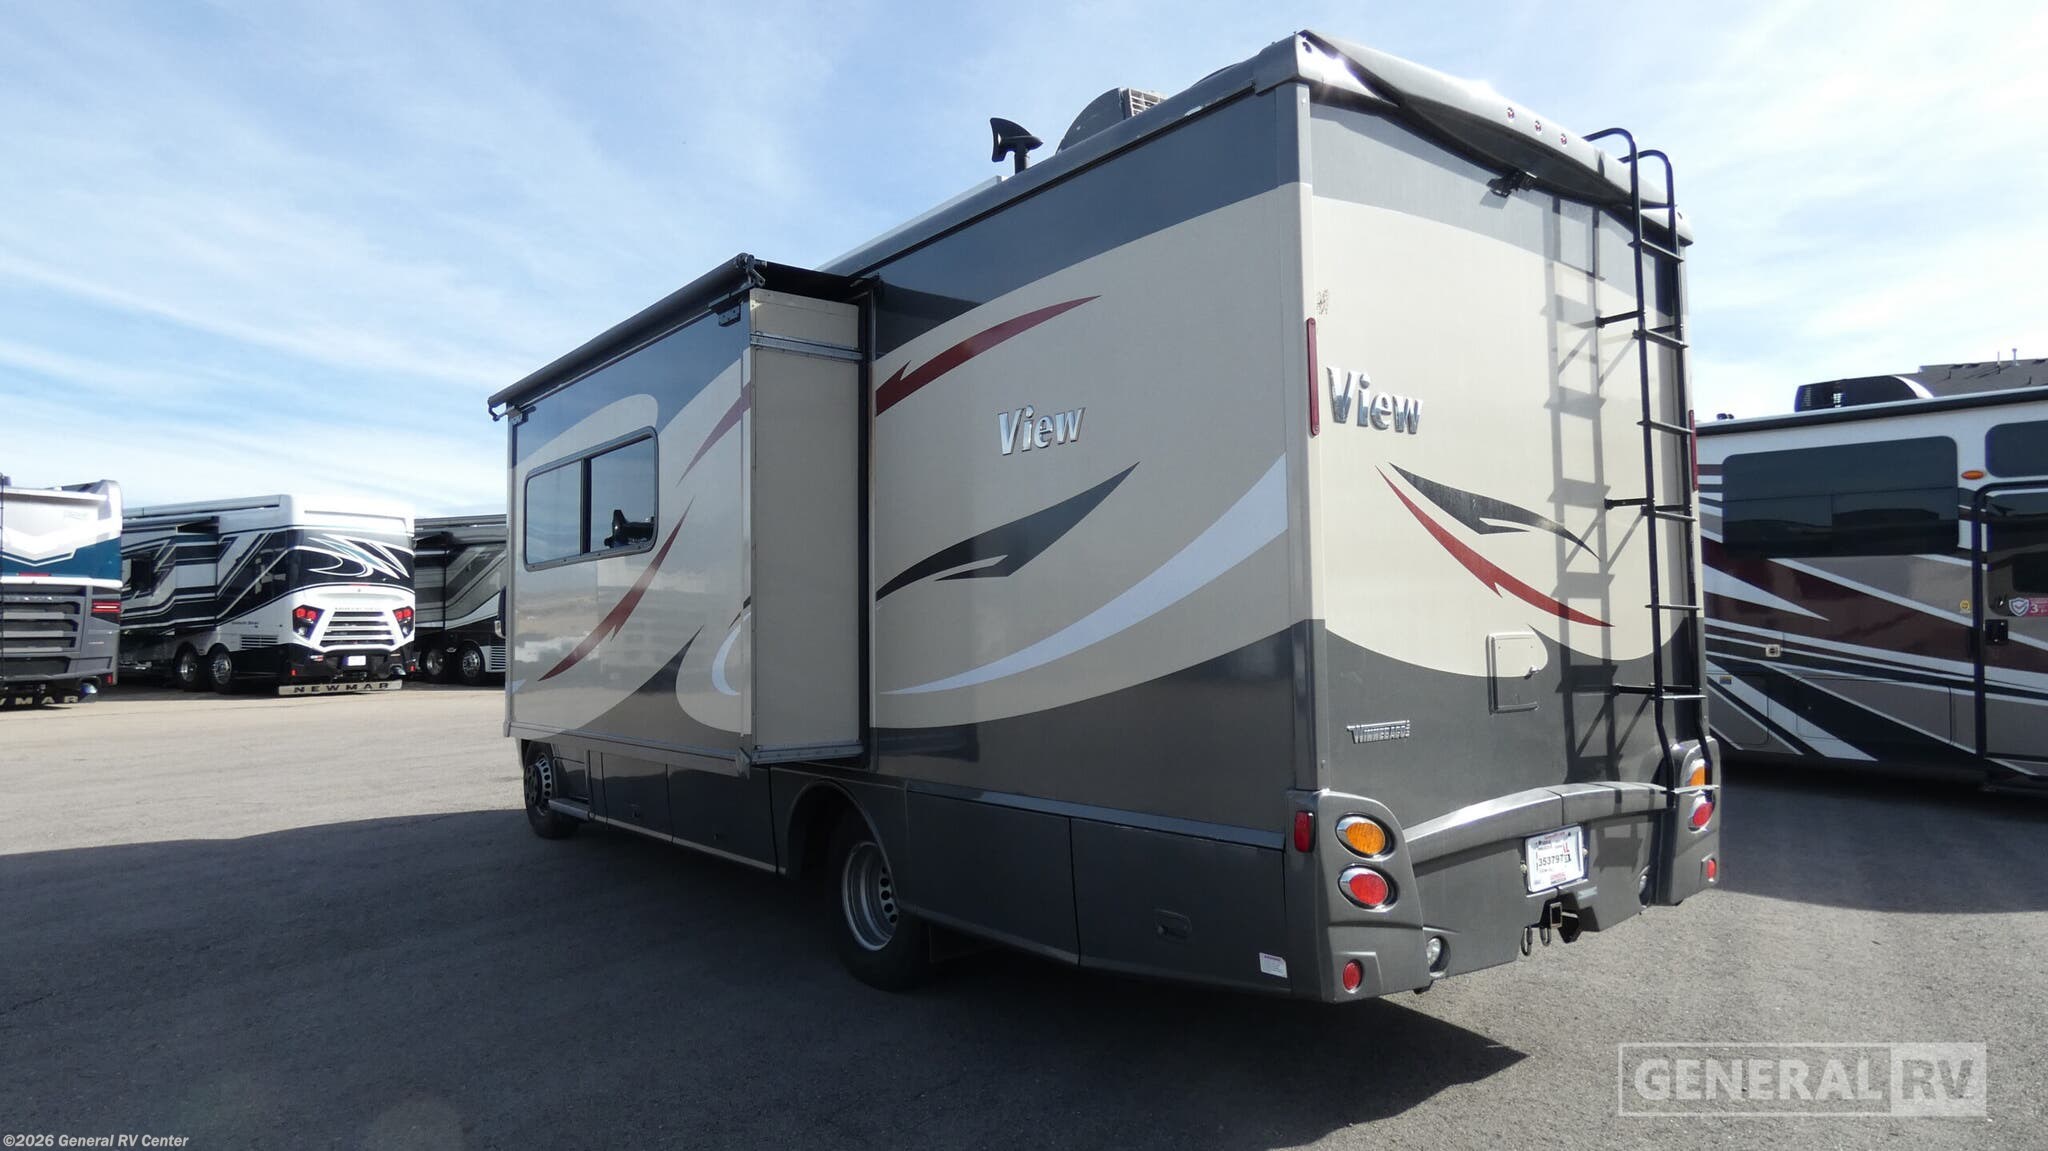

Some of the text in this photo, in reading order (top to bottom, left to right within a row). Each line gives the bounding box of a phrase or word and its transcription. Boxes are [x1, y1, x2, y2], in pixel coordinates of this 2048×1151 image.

[1326, 366, 1424, 436] View
[998, 404, 1086, 456] View
[293, 682, 390, 694] NEWMAR
